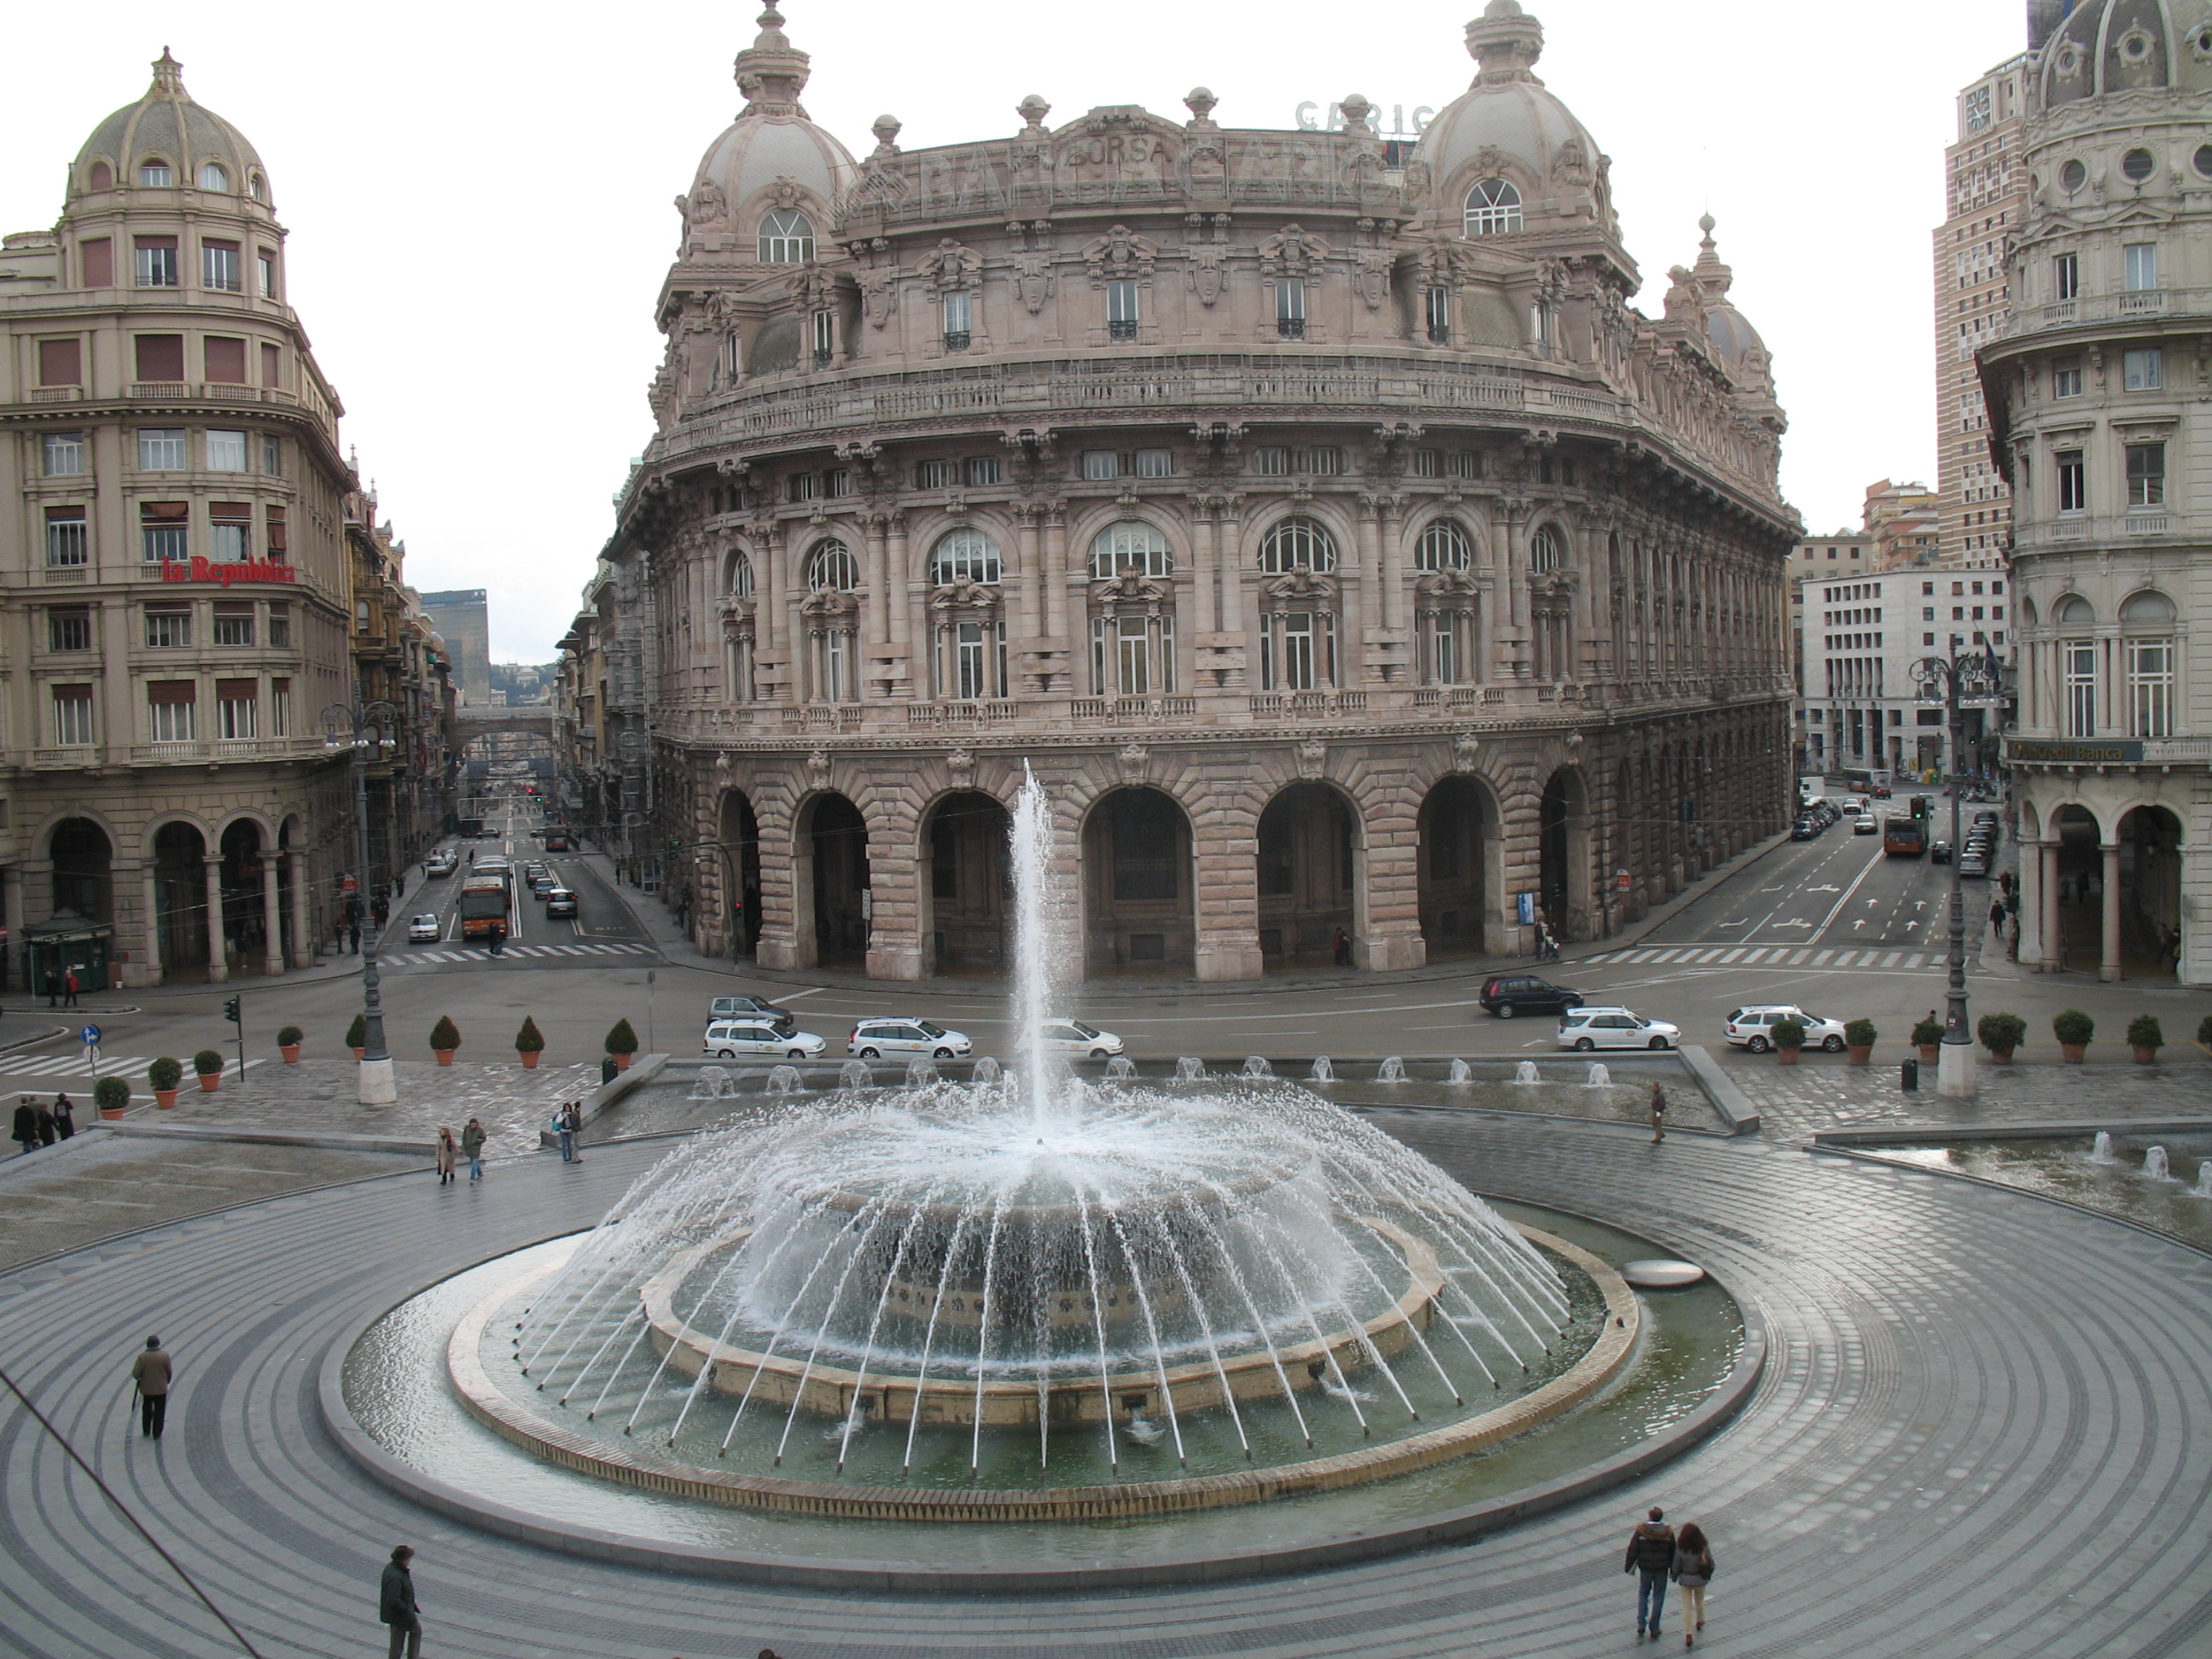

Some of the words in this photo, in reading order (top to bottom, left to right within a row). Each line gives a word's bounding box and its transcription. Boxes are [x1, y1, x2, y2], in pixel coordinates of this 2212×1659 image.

[1066, 135, 1173, 166] BORSA
[920, 137, 1167, 218] BANCA
[161, 556, 185, 582] la
[190, 556, 296, 587] Repubblica
[2077, 745, 2122, 760] Banca
